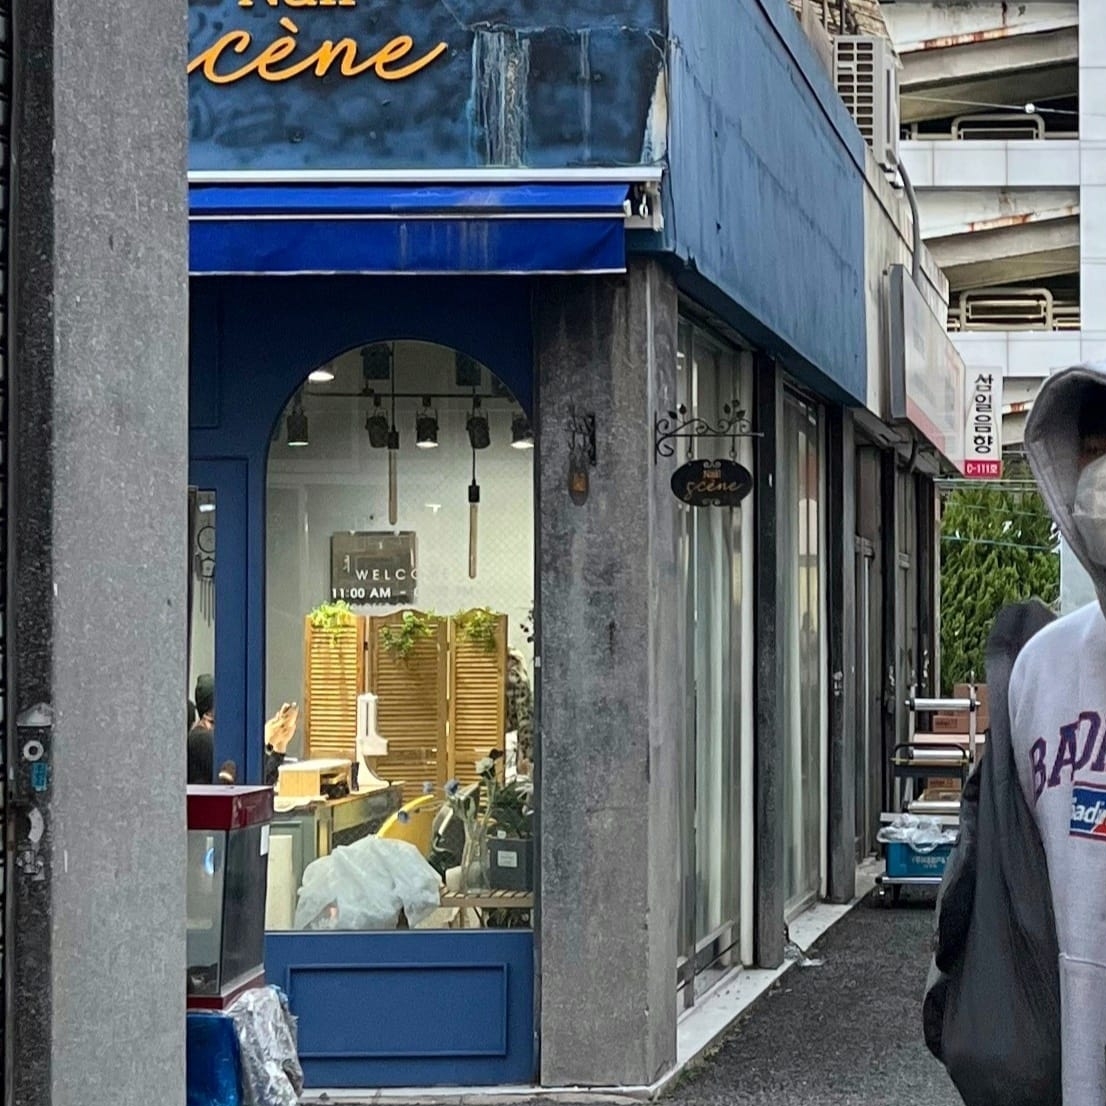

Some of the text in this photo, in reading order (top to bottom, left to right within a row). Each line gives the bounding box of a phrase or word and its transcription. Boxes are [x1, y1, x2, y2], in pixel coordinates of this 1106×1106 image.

[187, 17, 448, 84] cène
[974, 373, 994, 454] 삼일음향
[332, 587, 366, 599] 11:00
[369, 587, 392, 599] AM
